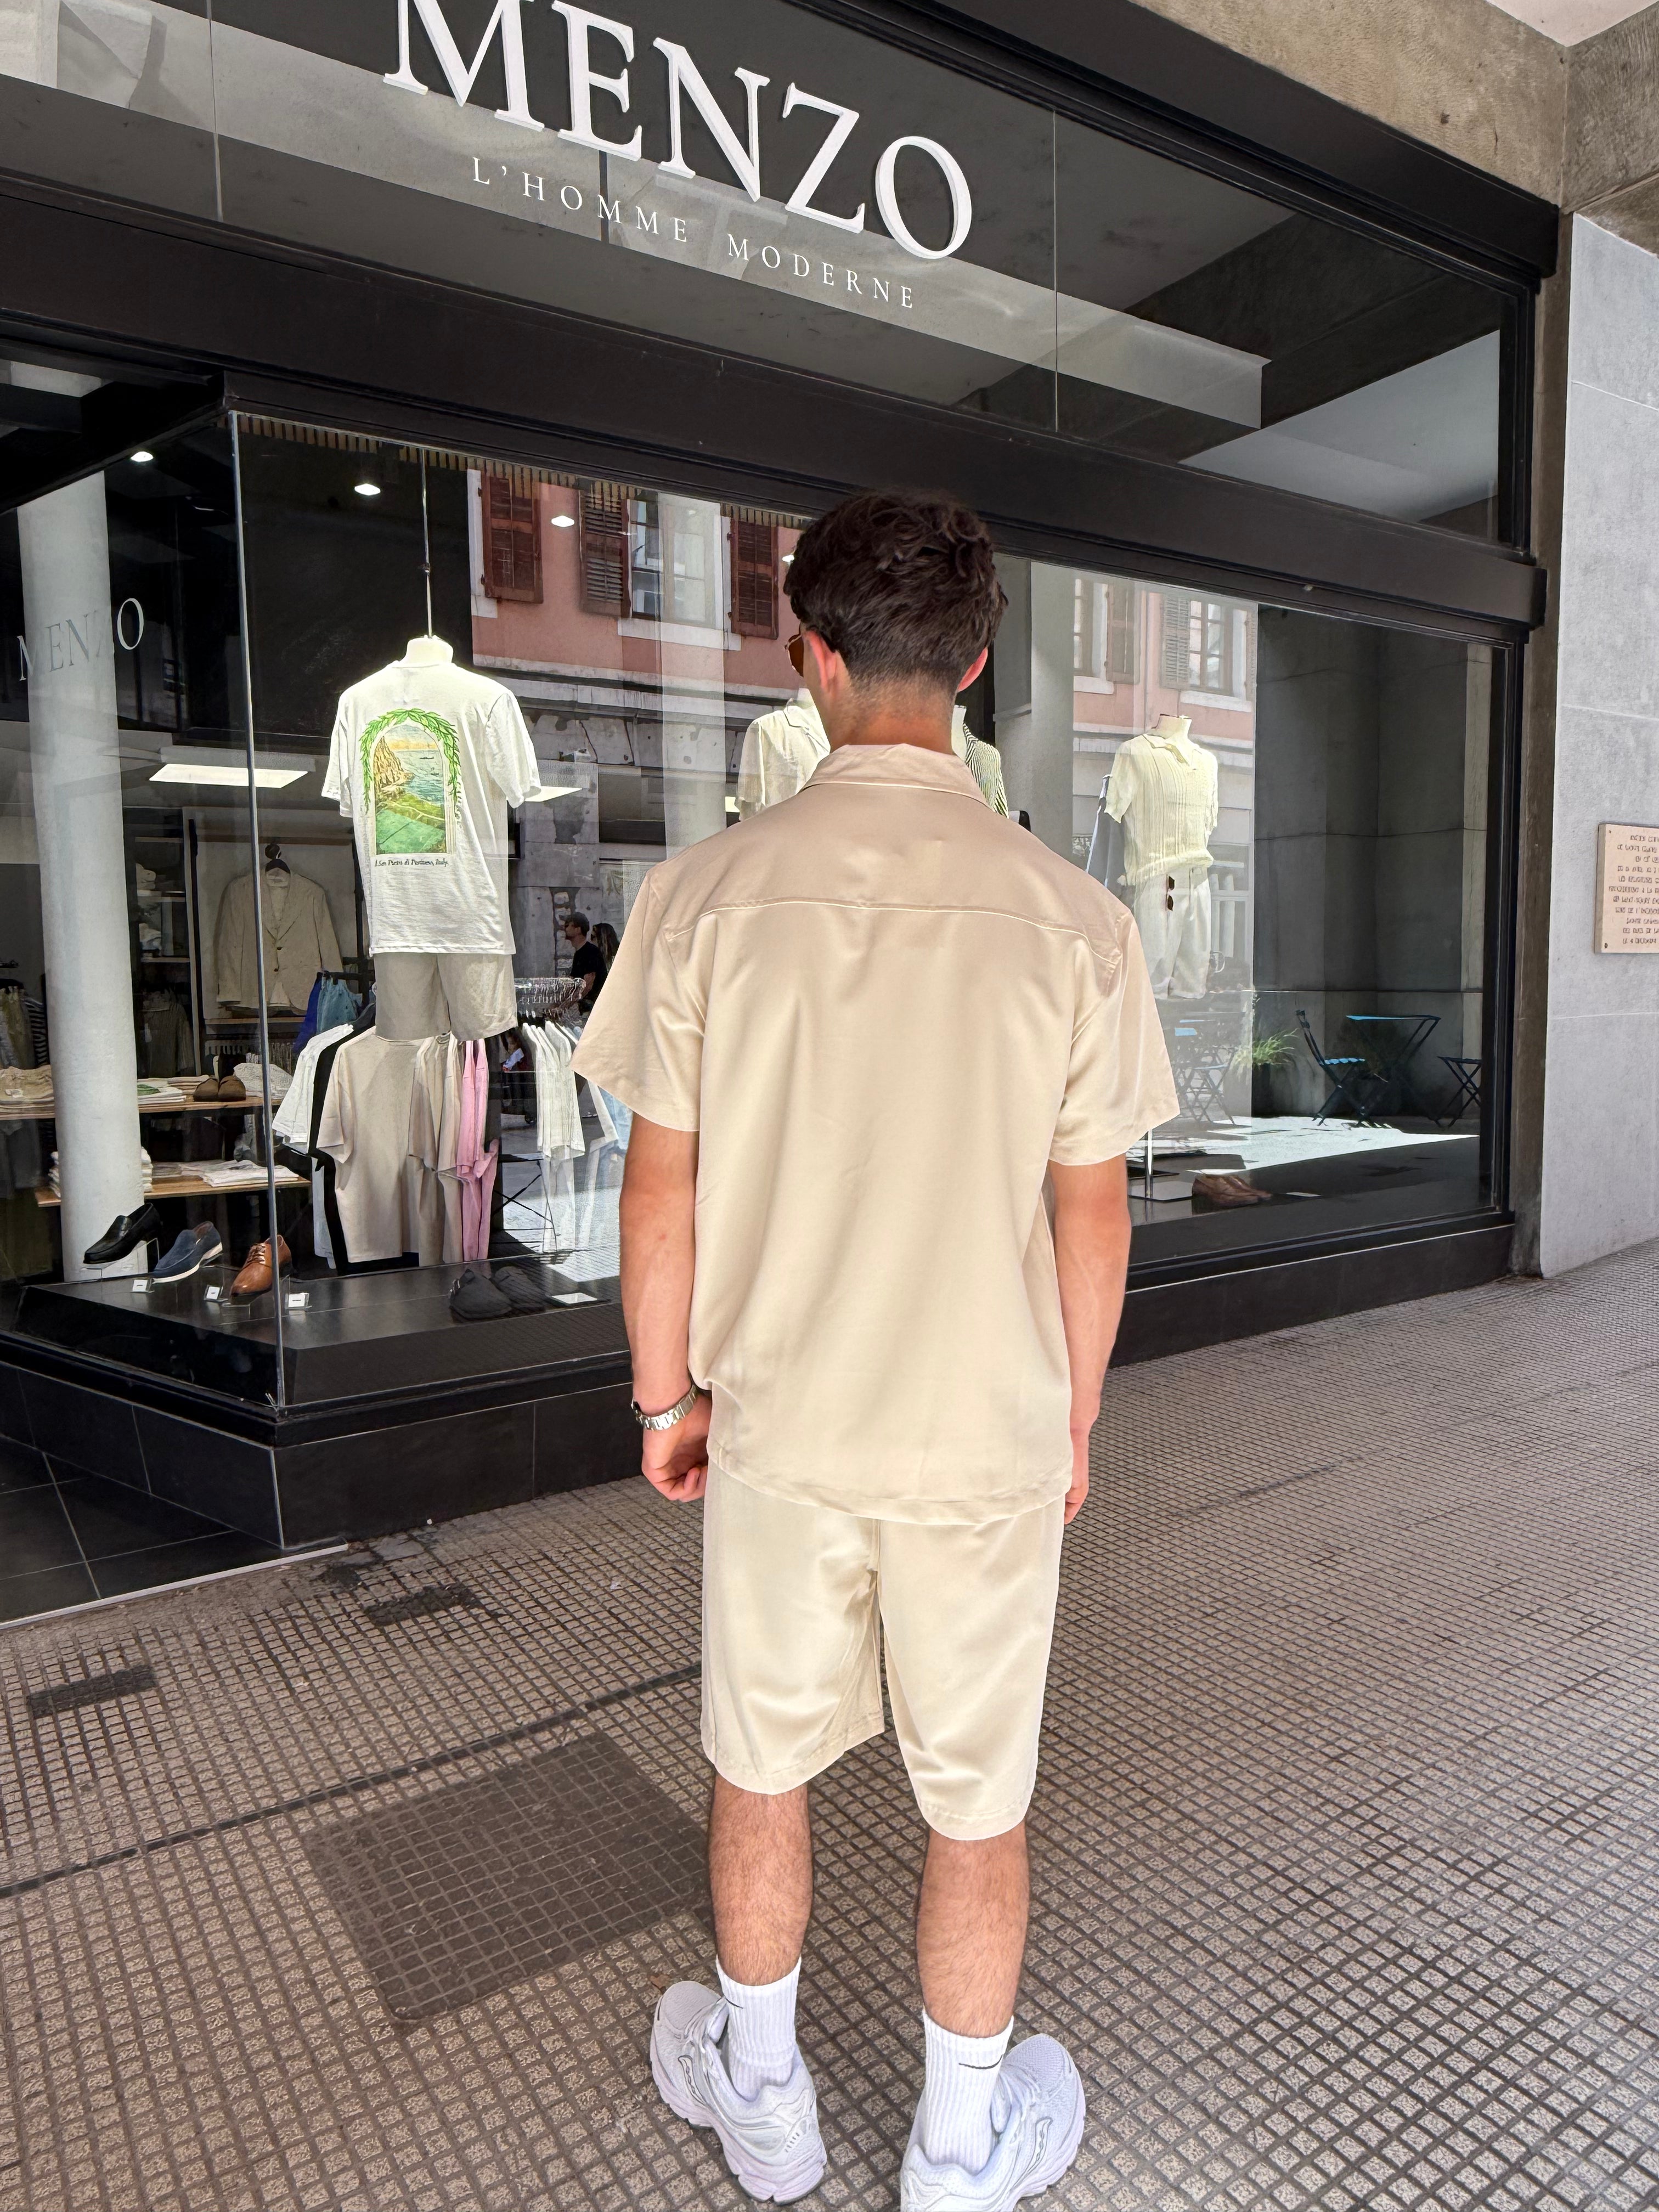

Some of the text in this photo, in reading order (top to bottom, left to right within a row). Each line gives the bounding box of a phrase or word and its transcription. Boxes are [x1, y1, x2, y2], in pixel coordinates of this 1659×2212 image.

[382, 0, 972, 260] MENZO
[472, 157, 913, 309] L’HOMME MODERNE
